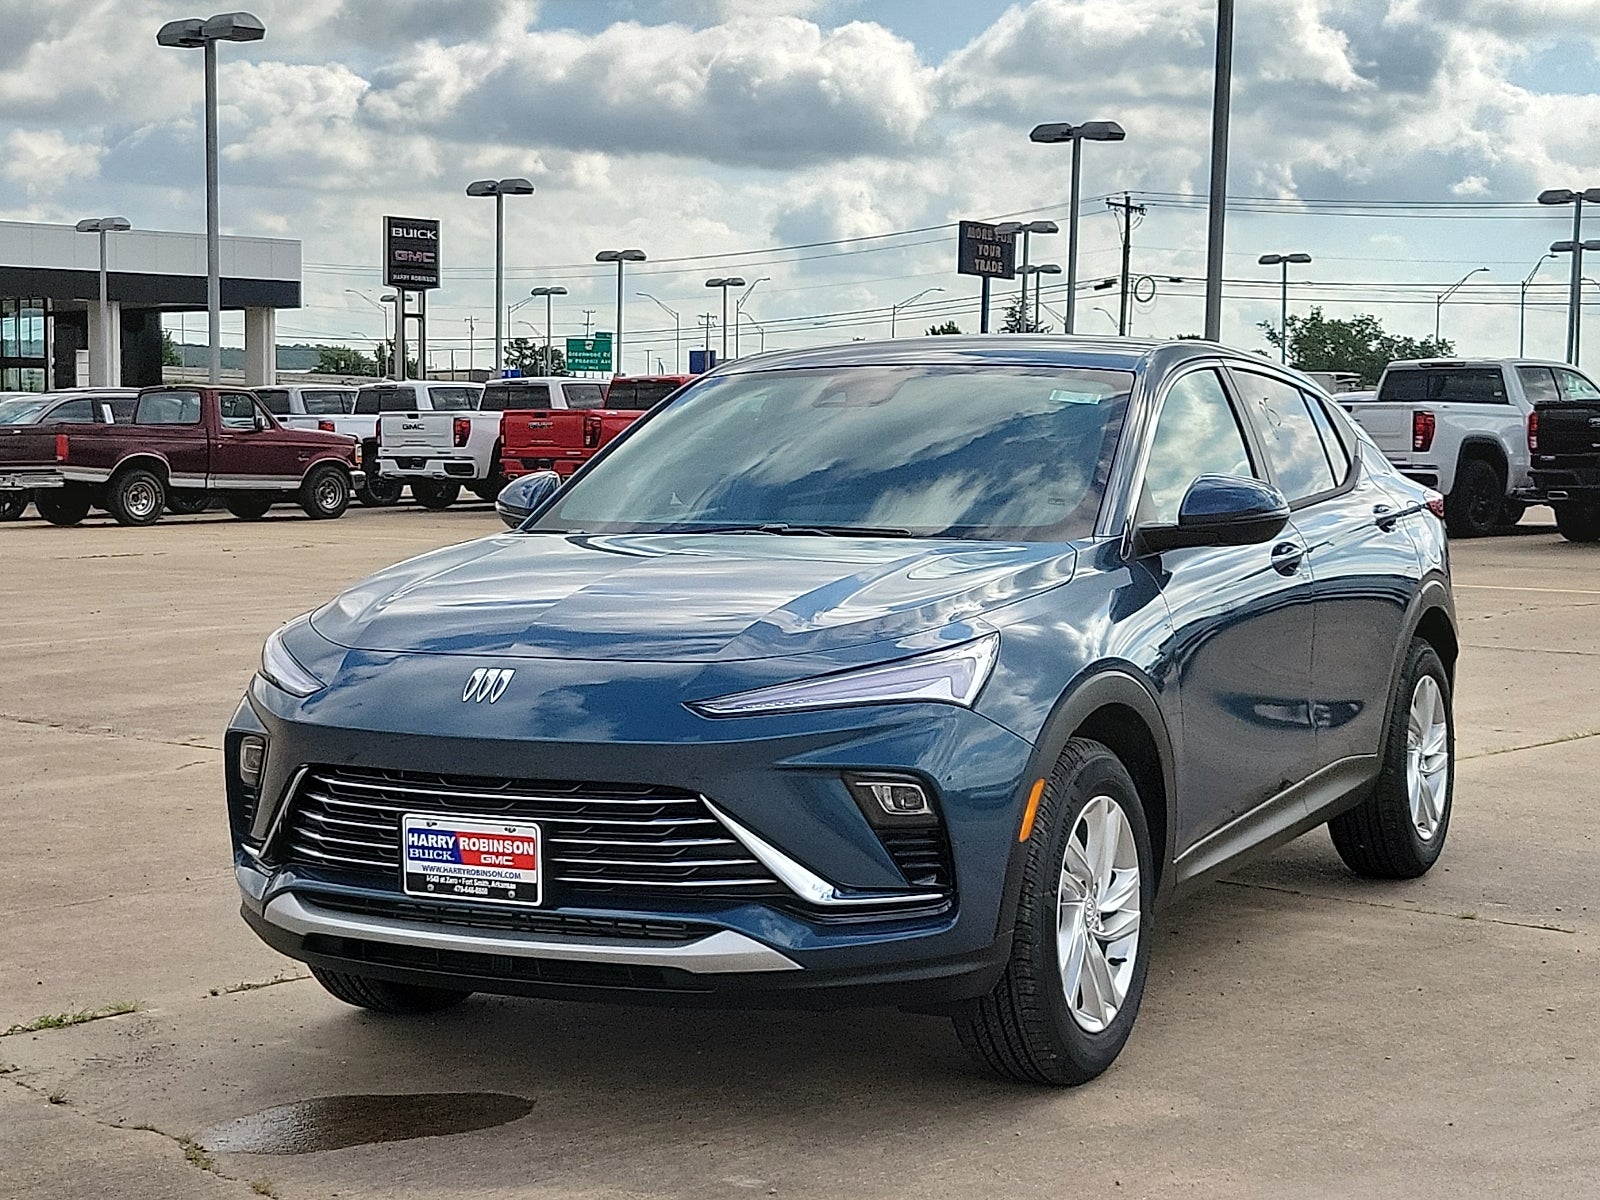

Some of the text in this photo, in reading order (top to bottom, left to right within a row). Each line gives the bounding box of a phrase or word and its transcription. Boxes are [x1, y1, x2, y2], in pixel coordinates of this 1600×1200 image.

[392, 227, 437, 240] BUICK
[967, 226, 993, 241] MORE
[395, 250, 435, 263] GMC
[977, 244, 1001, 258] YOUR
[974, 258, 1003, 273] TRADE
[402, 423, 425, 431] GMC
[408, 832, 534, 855] HARRY ROBINSON
[409, 848, 455, 860] BUICK
[480, 854, 515, 866] GMC
[421, 864, 522, 880] WWW.HARRYROBINSON.COM
[462, 878, 473, 886] Fort
